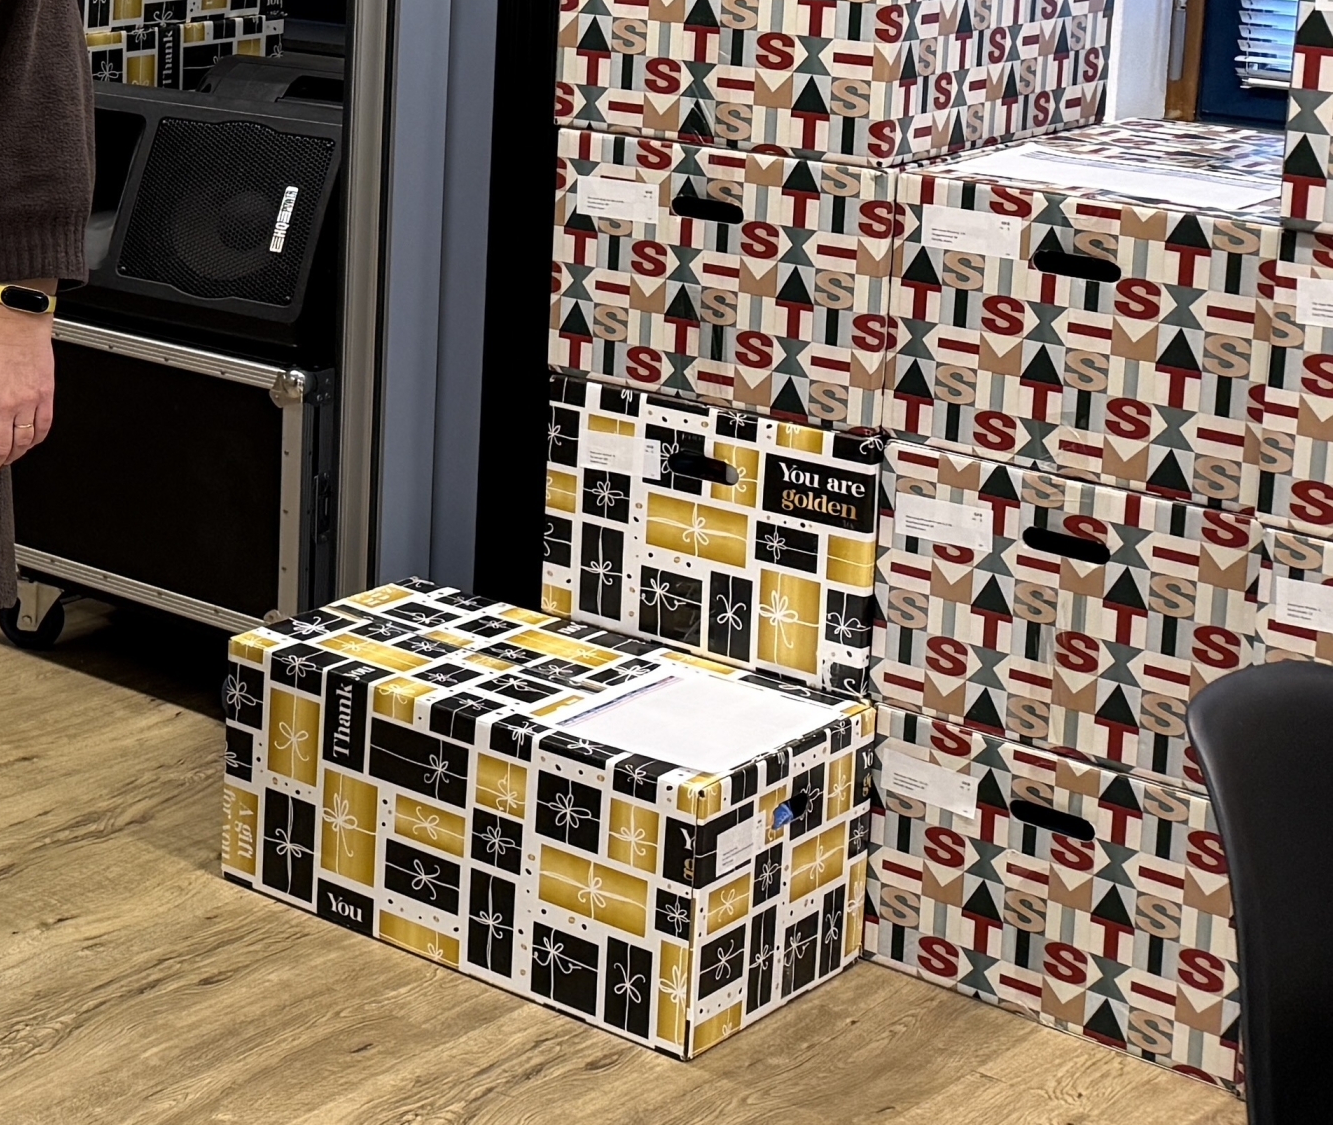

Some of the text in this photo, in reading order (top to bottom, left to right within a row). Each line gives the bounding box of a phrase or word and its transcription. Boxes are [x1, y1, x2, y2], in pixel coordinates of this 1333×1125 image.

[778, 461, 866, 498] You are
[781, 489, 858, 520] golden
[343, 665, 376, 681] you
[332, 683, 353, 758] Thank
[234, 820, 253, 859] gift
[327, 892, 363, 923] You
